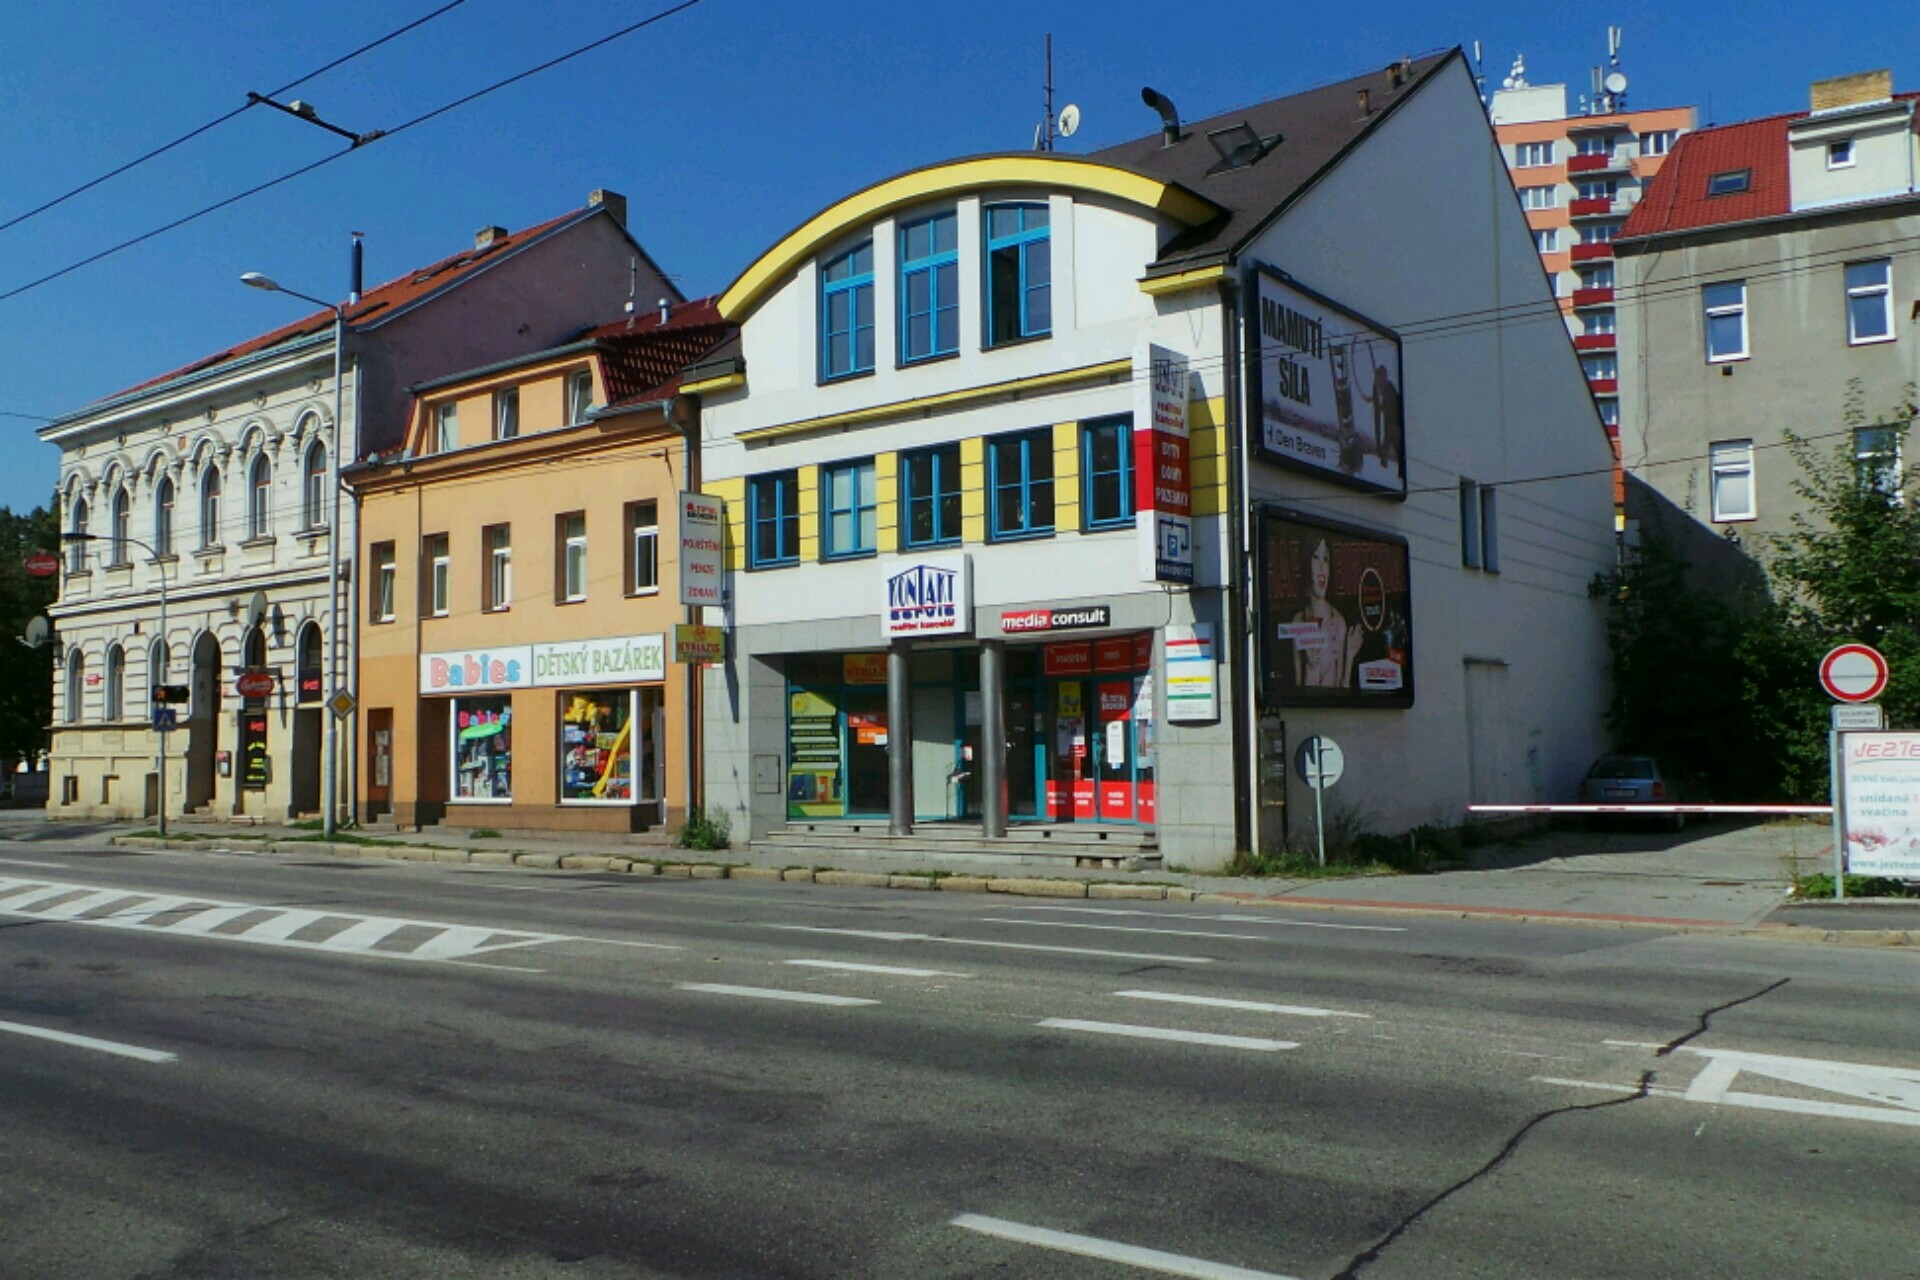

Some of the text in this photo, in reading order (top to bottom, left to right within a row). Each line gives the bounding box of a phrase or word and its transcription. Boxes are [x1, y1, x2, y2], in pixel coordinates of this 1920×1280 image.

[1261, 296, 1323, 360] MAMUTÍ
[1279, 353, 1311, 407] SÍLA
[1275, 429, 1327, 460] Den Braven
[886, 565, 958, 607] KONTAKT
[1002, 608, 1106, 630] media consult
[430, 653, 522, 688] Babies
[536, 640, 662, 677] DĚTSKÝ BAZÁREK
